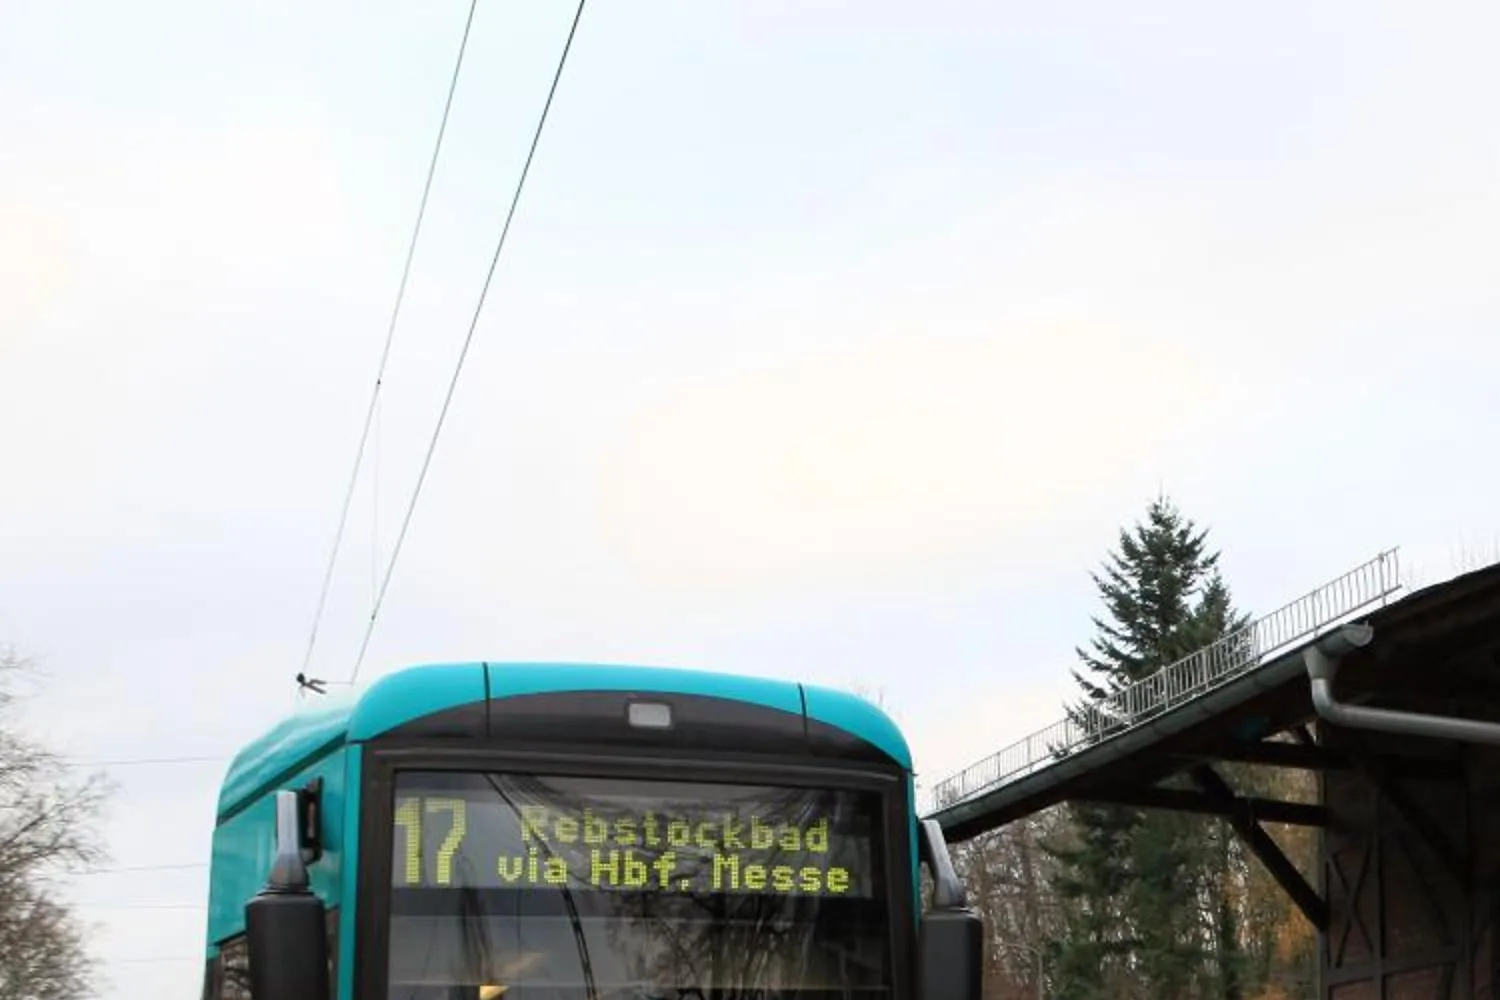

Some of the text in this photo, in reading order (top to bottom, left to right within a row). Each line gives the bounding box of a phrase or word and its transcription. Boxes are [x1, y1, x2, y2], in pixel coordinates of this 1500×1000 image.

[394, 797, 467, 885] 17
[521, 805, 828, 853] Rebstockbad
[498, 847, 568, 884] via
[712, 853, 850, 893] Messe
